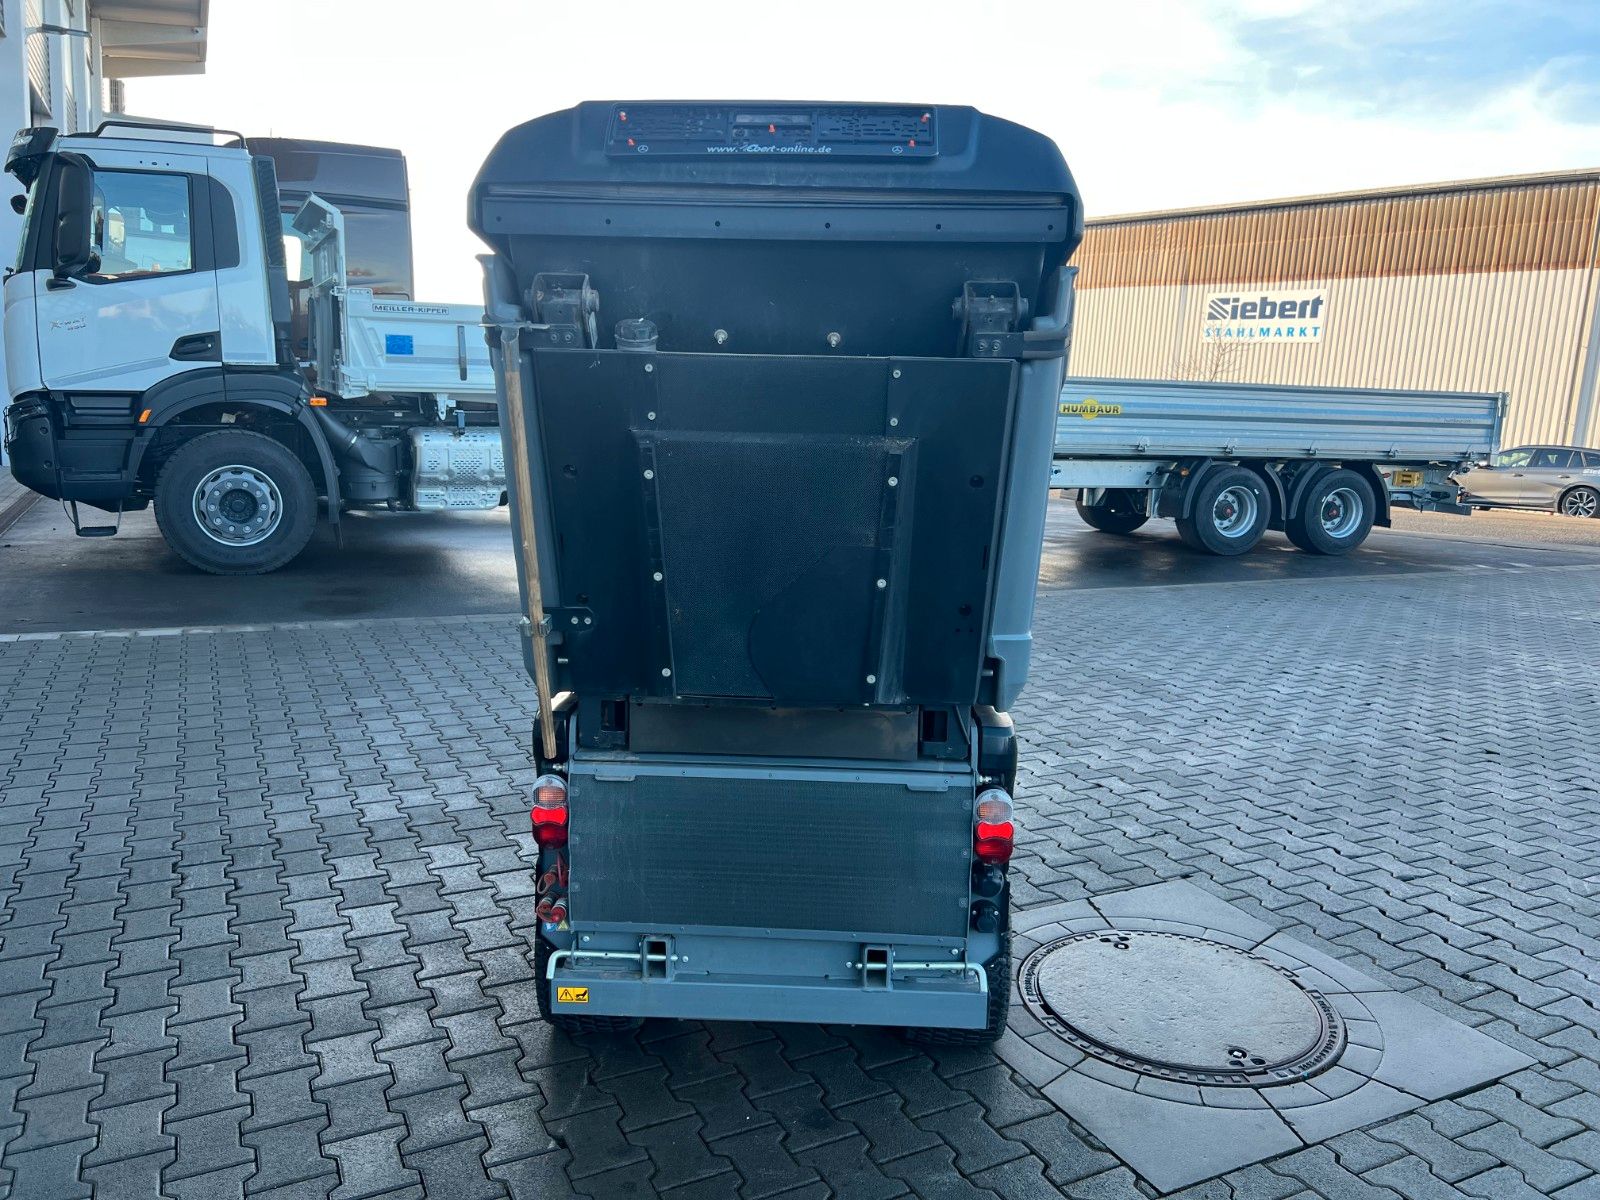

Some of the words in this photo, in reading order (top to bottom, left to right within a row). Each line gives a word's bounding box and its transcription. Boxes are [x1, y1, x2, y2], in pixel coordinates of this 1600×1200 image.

[1207, 295, 1323, 320] Siebert
[1204, 327, 1320, 338] STAHLMARKT
[1063, 405, 1119, 414] HUMBAUR
